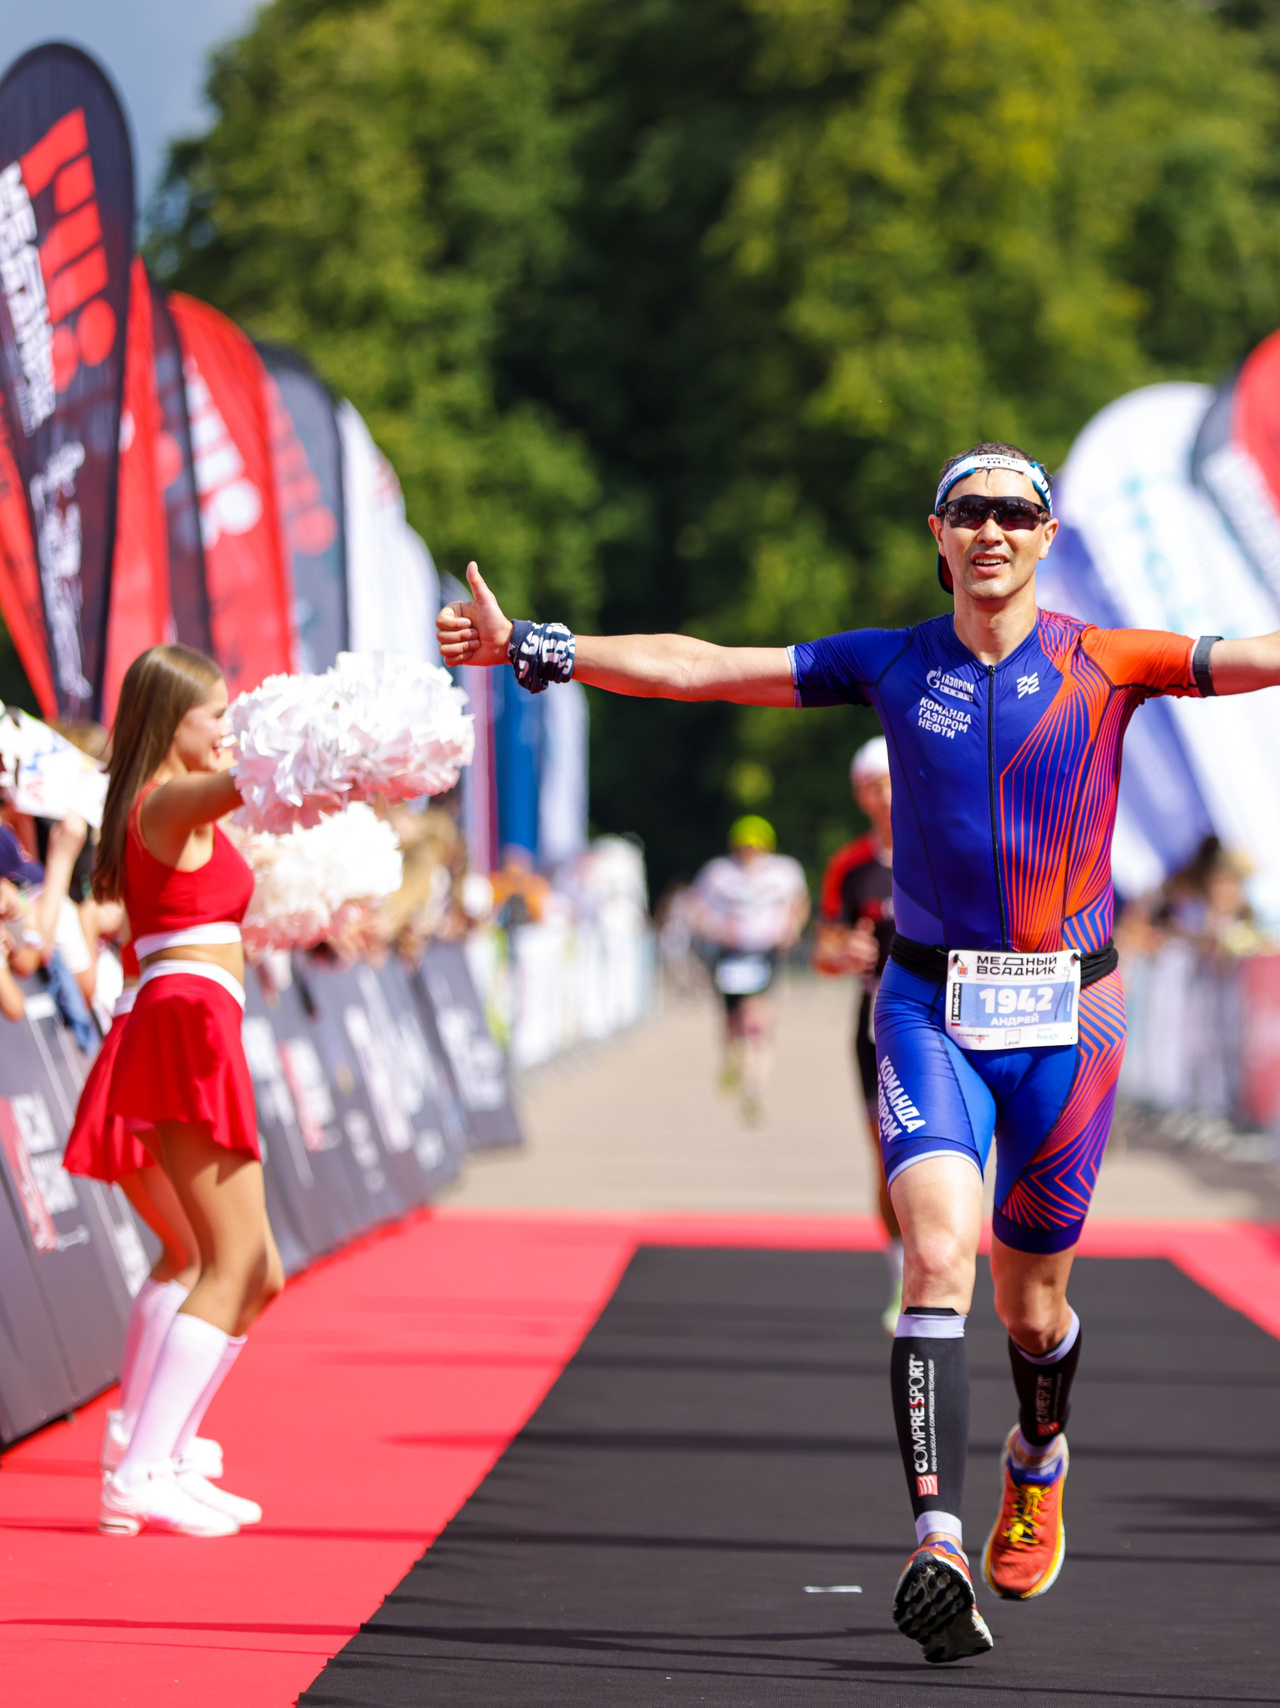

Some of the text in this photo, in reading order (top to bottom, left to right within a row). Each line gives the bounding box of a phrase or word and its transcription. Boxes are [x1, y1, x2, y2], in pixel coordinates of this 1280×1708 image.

[941, 674, 974, 694] ГАЗПРОМ
[918, 707, 969, 734] ГАЗПРОМ
[919, 696, 972, 725] КОМАНДА
[918, 717, 956, 740] НЕФТИ
[976, 955, 1058, 966] МЕДНЫЙ
[976, 966, 1056, 976] ВСАДНИК
[978, 986, 1054, 1015] 1942
[990, 1012, 1040, 1027] АНДРЕЙ
[880, 1055, 927, 1134] КОМАНДА
